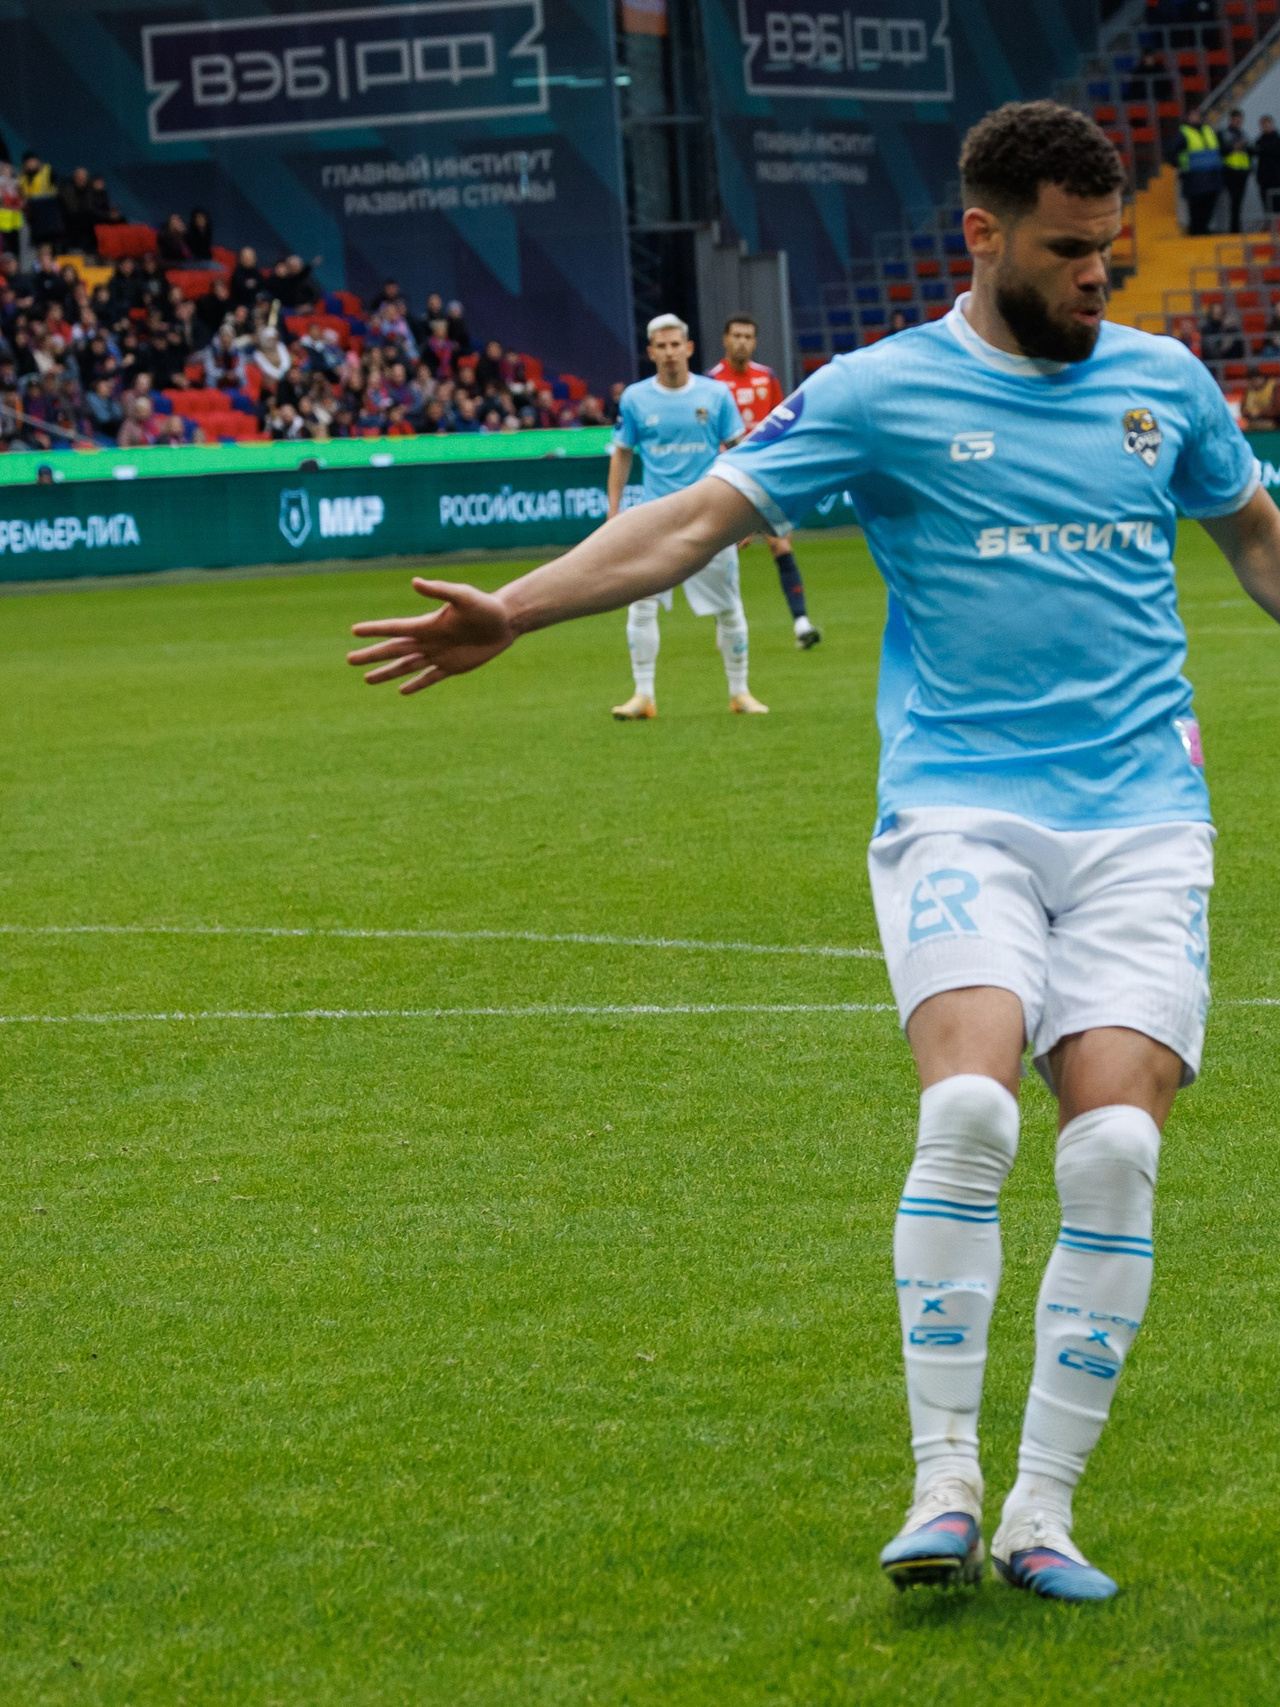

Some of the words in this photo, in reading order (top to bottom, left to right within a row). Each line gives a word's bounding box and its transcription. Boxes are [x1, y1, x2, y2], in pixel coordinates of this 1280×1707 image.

[0, 513, 141, 554] РЕМЬЕР-ЛИГА
[319, 496, 384, 537] МИР
[975, 521, 1154, 558] БЕТСИТИ
